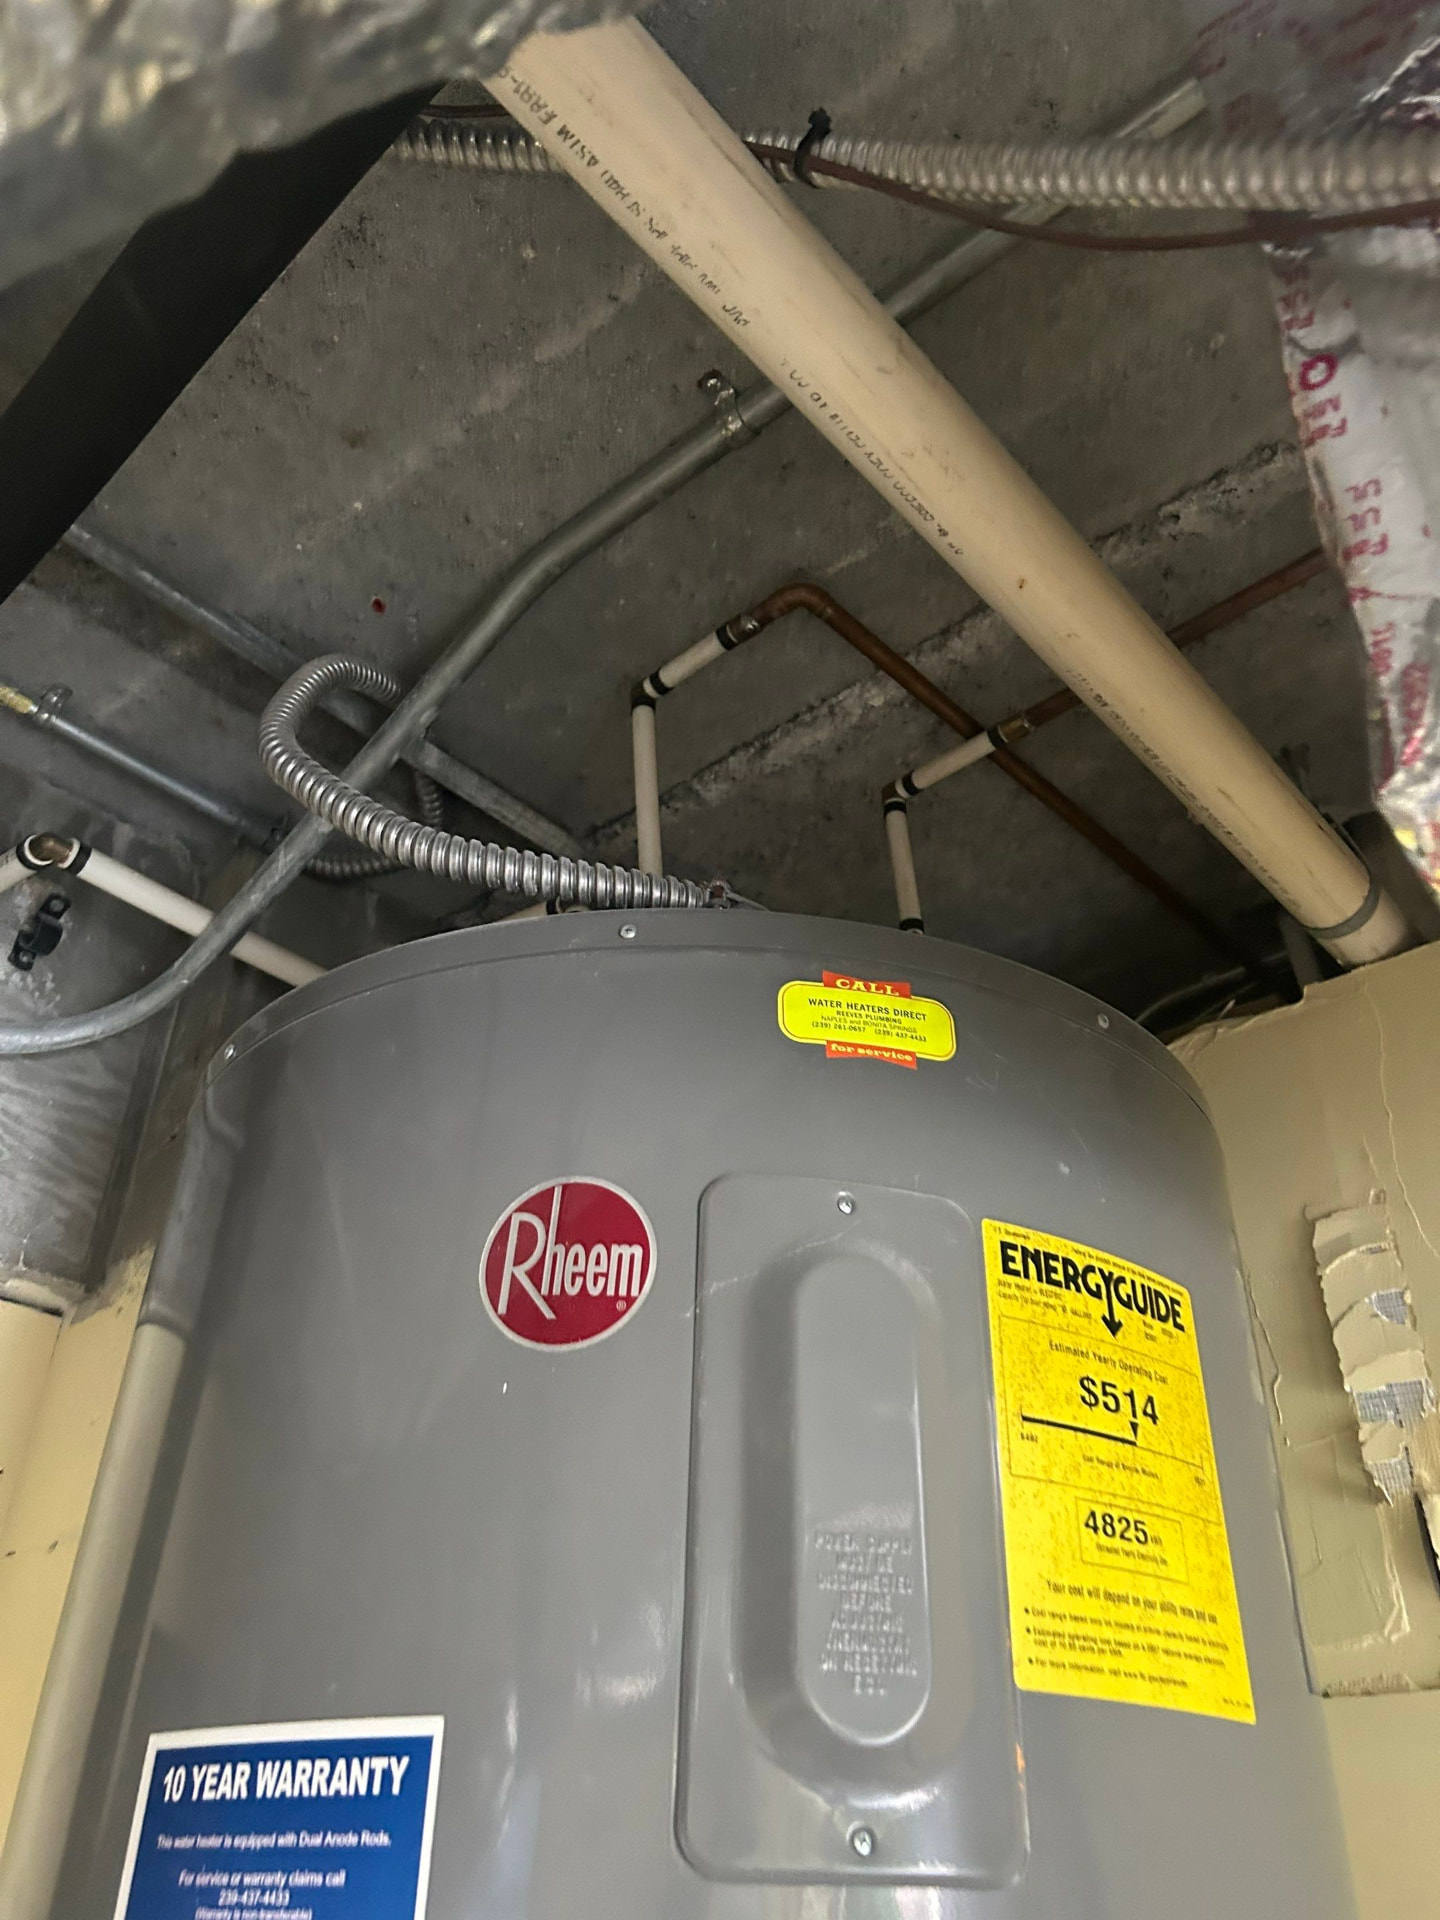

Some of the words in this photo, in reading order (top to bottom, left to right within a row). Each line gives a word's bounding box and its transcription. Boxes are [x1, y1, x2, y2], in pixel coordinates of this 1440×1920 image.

[836, 979, 899, 996] CALL
[808, 998, 842, 1009] WATER
[846, 1001, 890, 1015] HEATERS
[893, 1008, 927, 1021] DIRECT
[836, 1010, 863, 1019] REEVES
[865, 1014, 902, 1024] PLUMBING
[811, 1021, 831, 1030] (239)
[874, 1029, 893, 1037] (239)
[821, 1015, 847, 1024] NAPLES
[863, 1020, 888, 1029] BONITA
[889, 1024, 918, 1034] SPRINGS
[831, 1043, 855, 1053] for
[857, 1048, 913, 1062] service
[497, 1185, 643, 1320] Rheem
[1000, 1240, 1186, 1333] ENERGYGUIDE
[1048, 1340, 1090, 1361] Estimated
[1091, 1348, 1117, 1371] Yearly
[1118, 1356, 1153, 1381] Operating
[1078, 1374, 1160, 1426] $514
[1084, 1509, 1149, 1545] 4825
[163, 1765, 185, 1803] 10
[191, 1762, 250, 1801] YEAR
[255, 1755, 410, 1799] WARRANTY
[299, 1830, 323, 1848] Dual
[324, 1829, 359, 1848] Anode
[360, 1829, 391, 1848] Rods.
[178, 1868, 194, 1887] For
[243, 1870, 287, 1890] warranty
[288, 1869, 323, 1887] claims
[325, 1868, 346, 1887] call
